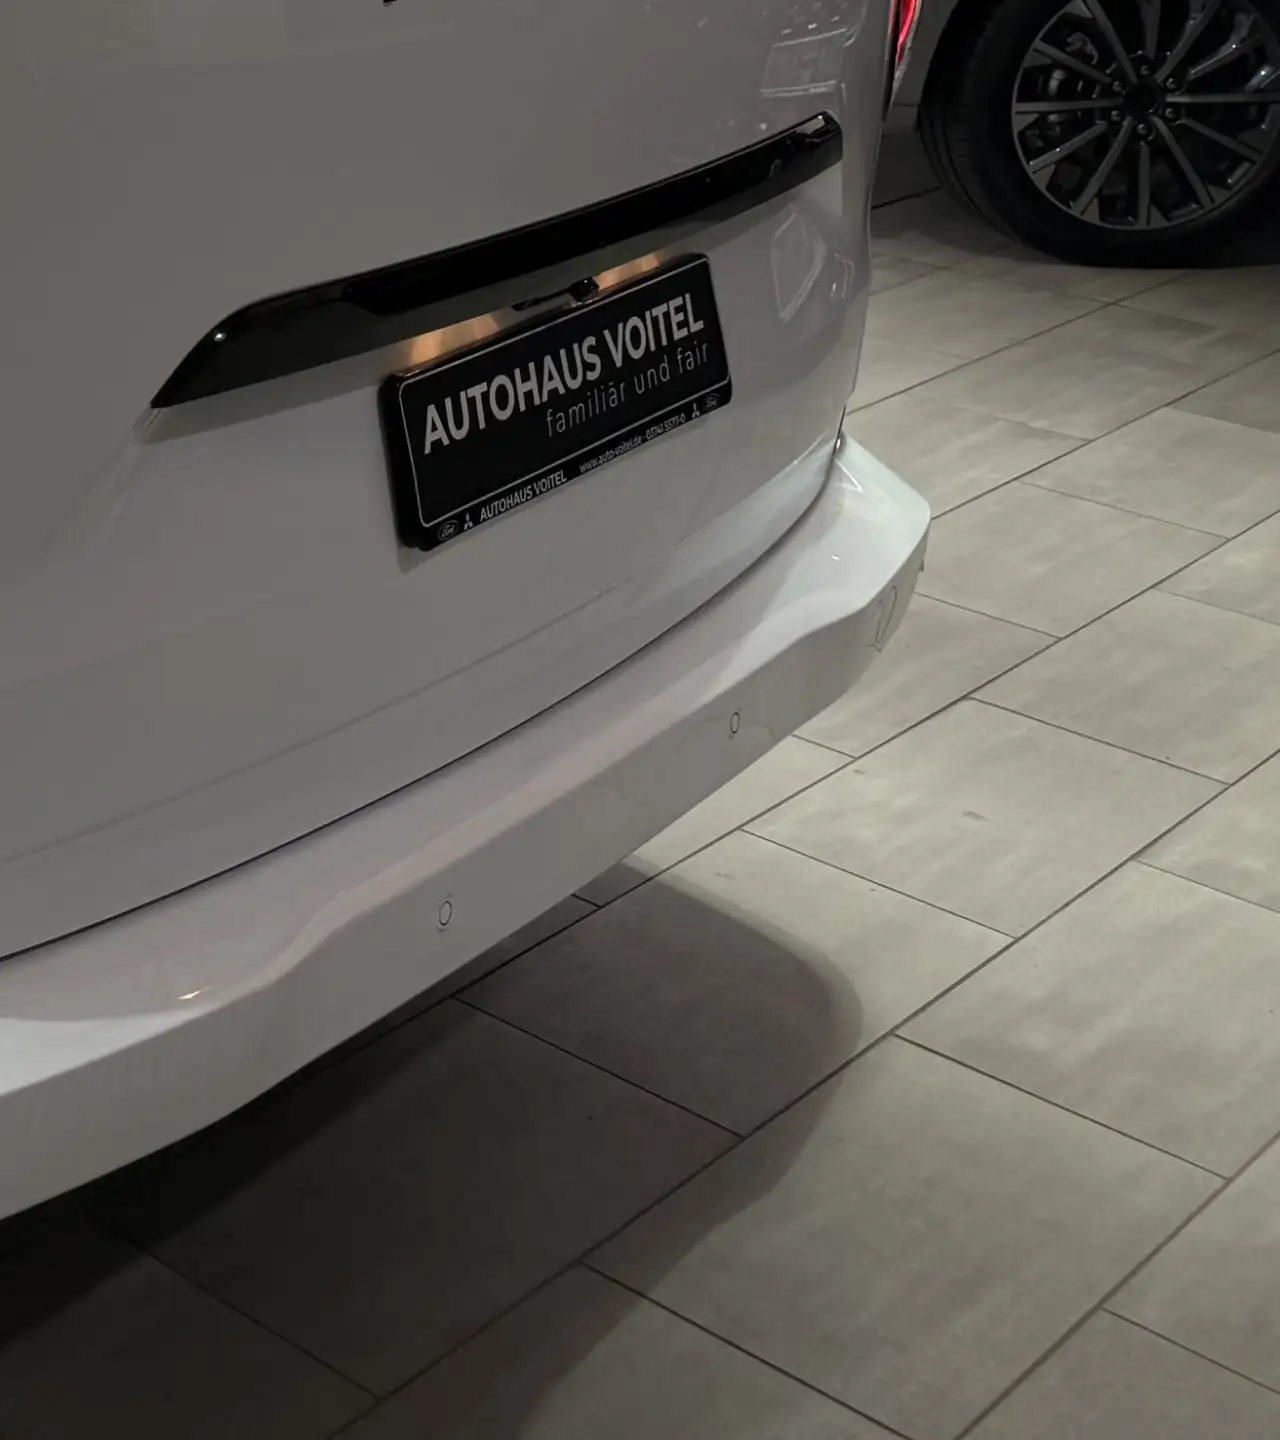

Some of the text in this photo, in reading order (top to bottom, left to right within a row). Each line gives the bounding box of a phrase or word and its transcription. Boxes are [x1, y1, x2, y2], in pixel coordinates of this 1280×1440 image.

[423, 291, 705, 455] AUTOHAUS VOITEL
[545, 340, 710, 438] familiär und fair
[479, 484, 533, 522] AUTOHAUS
[532, 469, 568, 496] VOITEL
